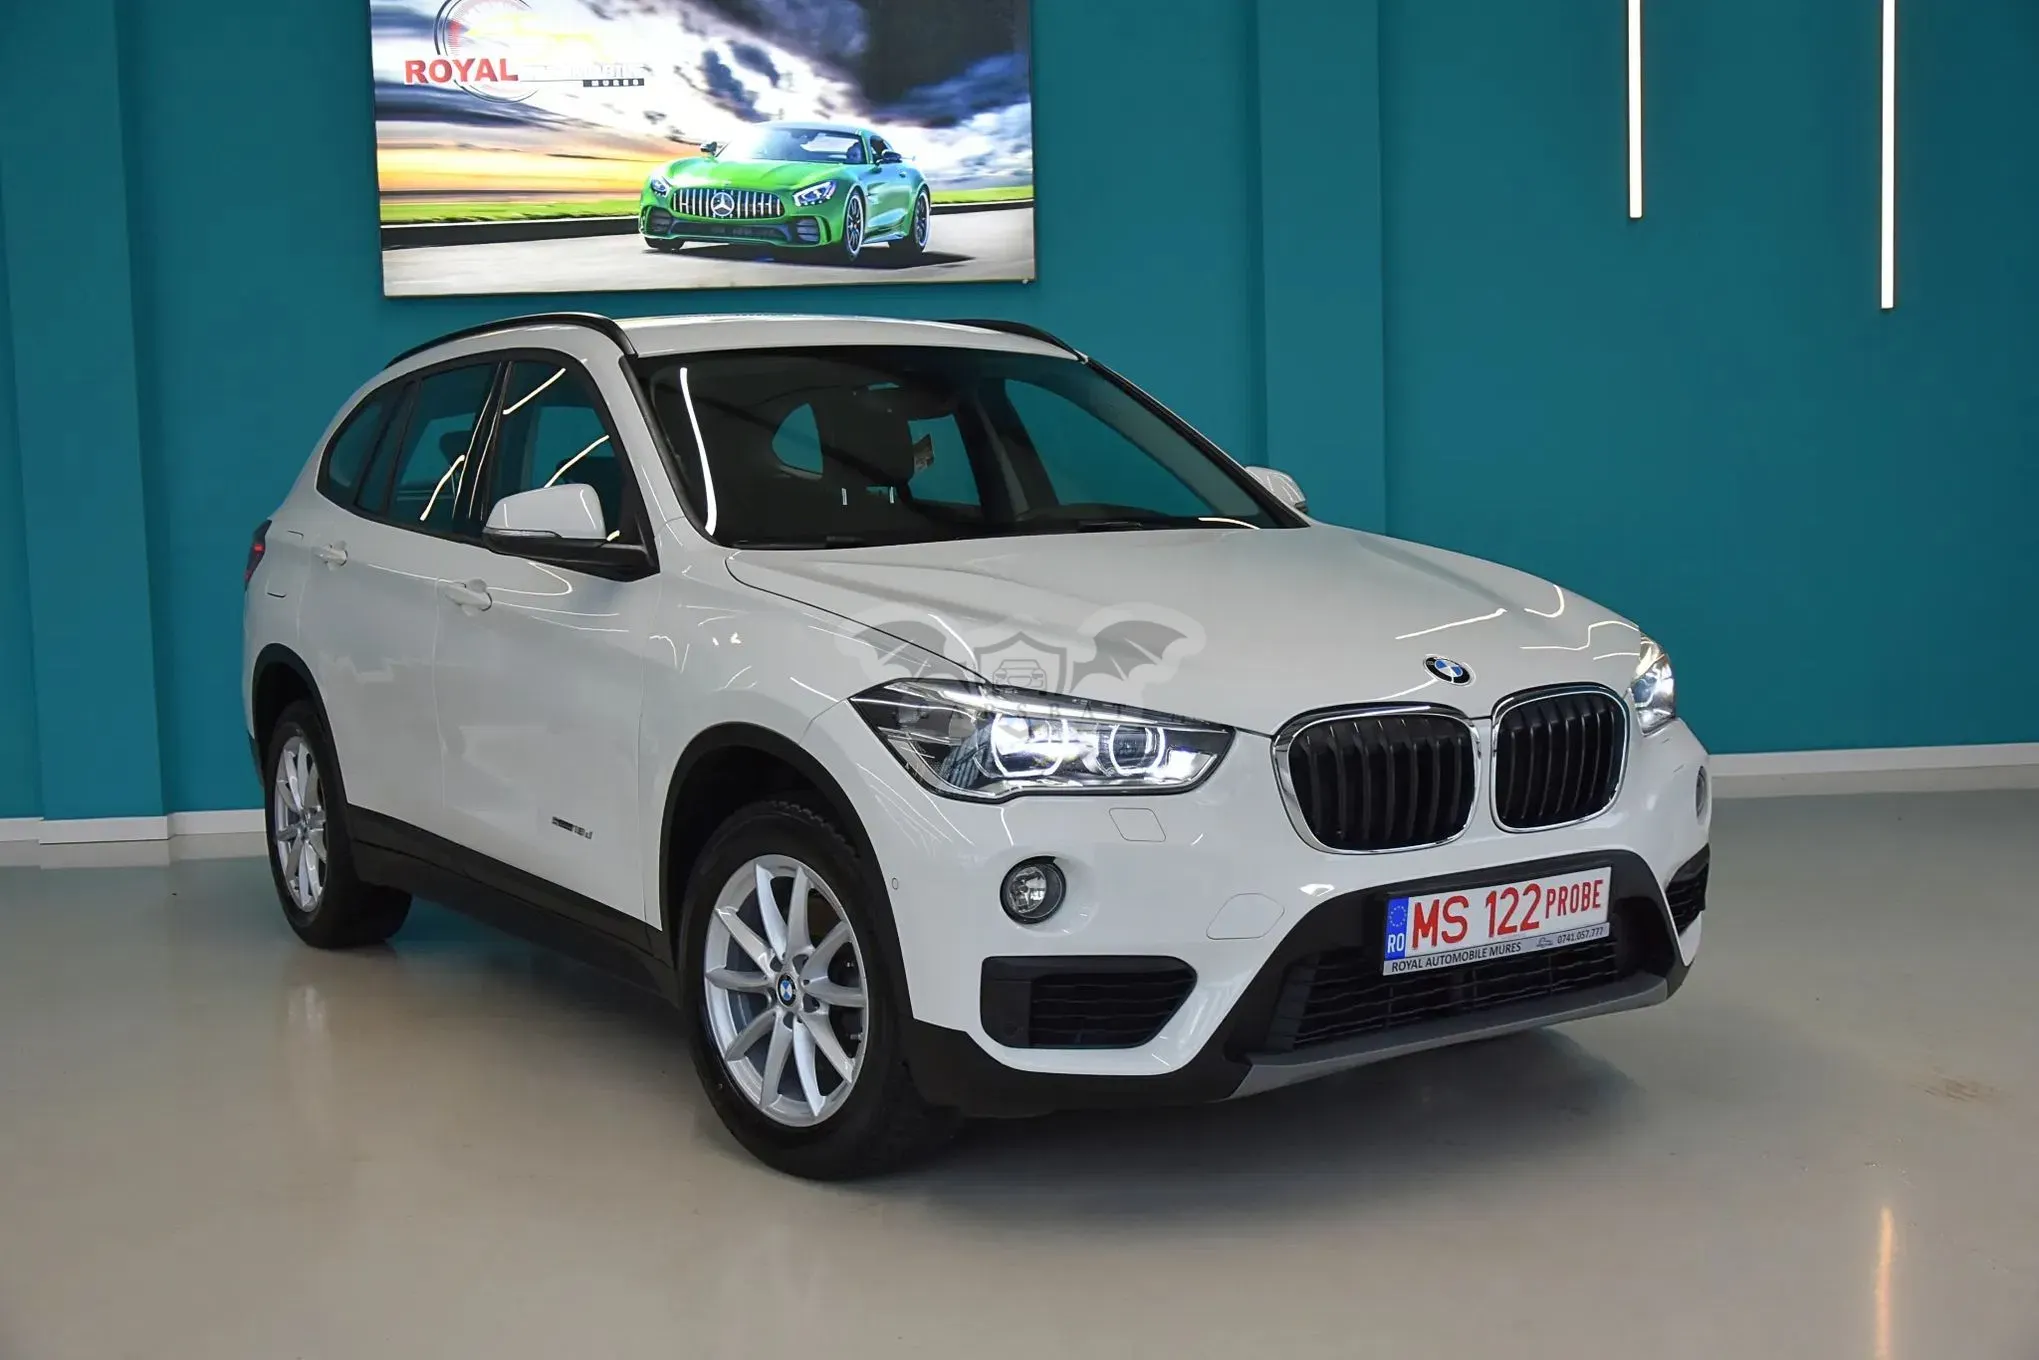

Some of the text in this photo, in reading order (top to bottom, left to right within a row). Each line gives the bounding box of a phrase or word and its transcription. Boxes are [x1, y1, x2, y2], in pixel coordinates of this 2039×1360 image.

[405, 58, 519, 84] ROYAL
[1412, 879, 1604, 950] MS 122 PROBE
[1387, 933, 1405, 953] RO
[1391, 958, 1423, 972] ROYAL
[1425, 948, 1488, 967] AUTOMOBILE
[1489, 942, 1521, 957] MURES
